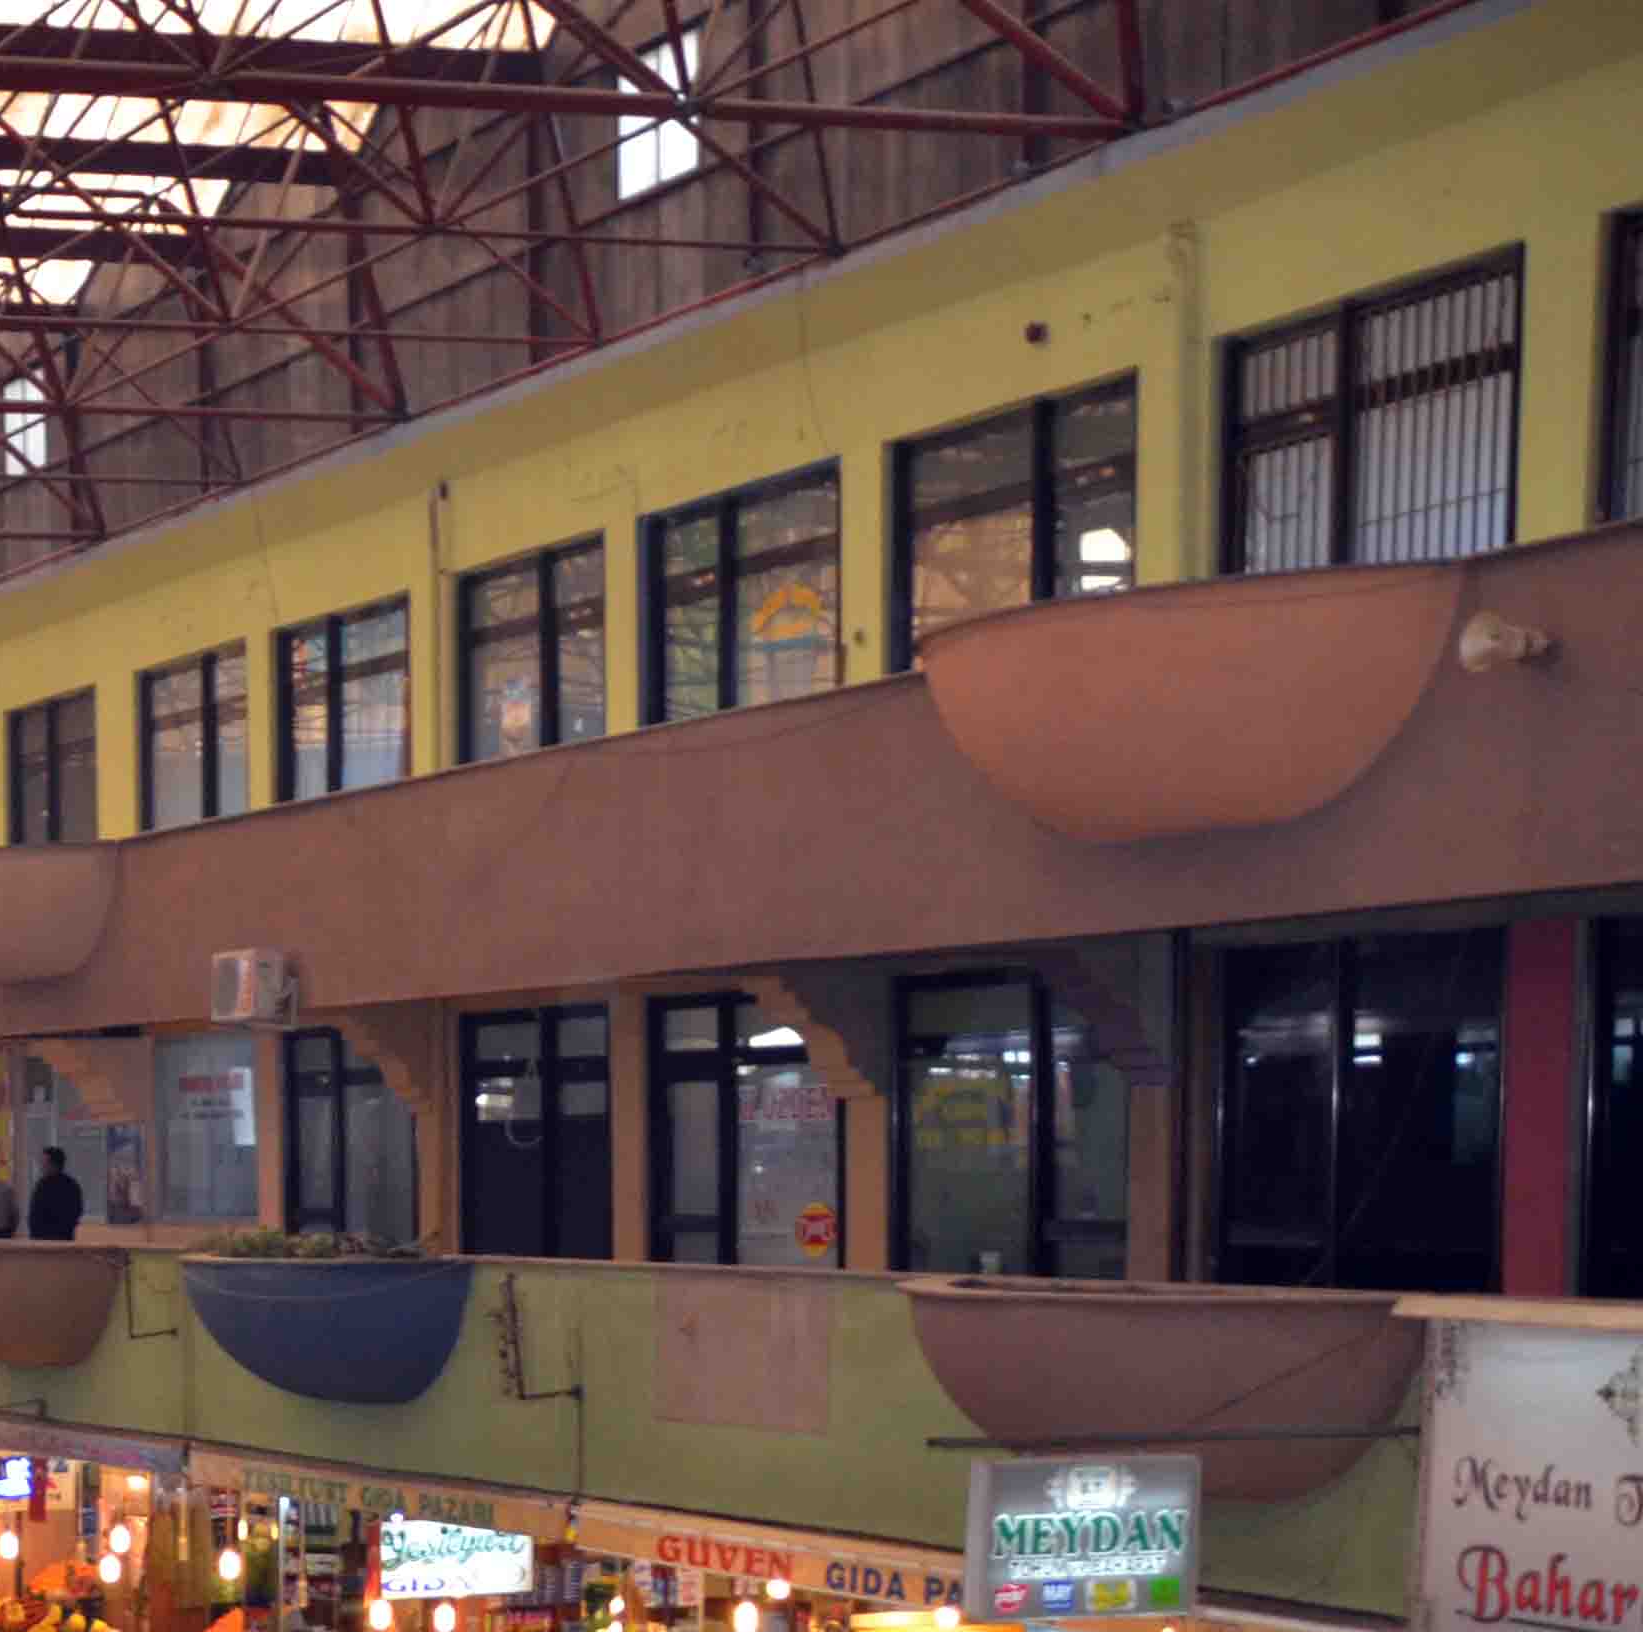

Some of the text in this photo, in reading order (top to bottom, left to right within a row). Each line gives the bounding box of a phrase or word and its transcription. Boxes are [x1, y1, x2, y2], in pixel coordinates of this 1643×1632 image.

[1452, 1456, 1593, 1524] Meydan
[992, 1508, 1189, 1557] MEYDAN
[826, 1561, 907, 1601] GIDA
